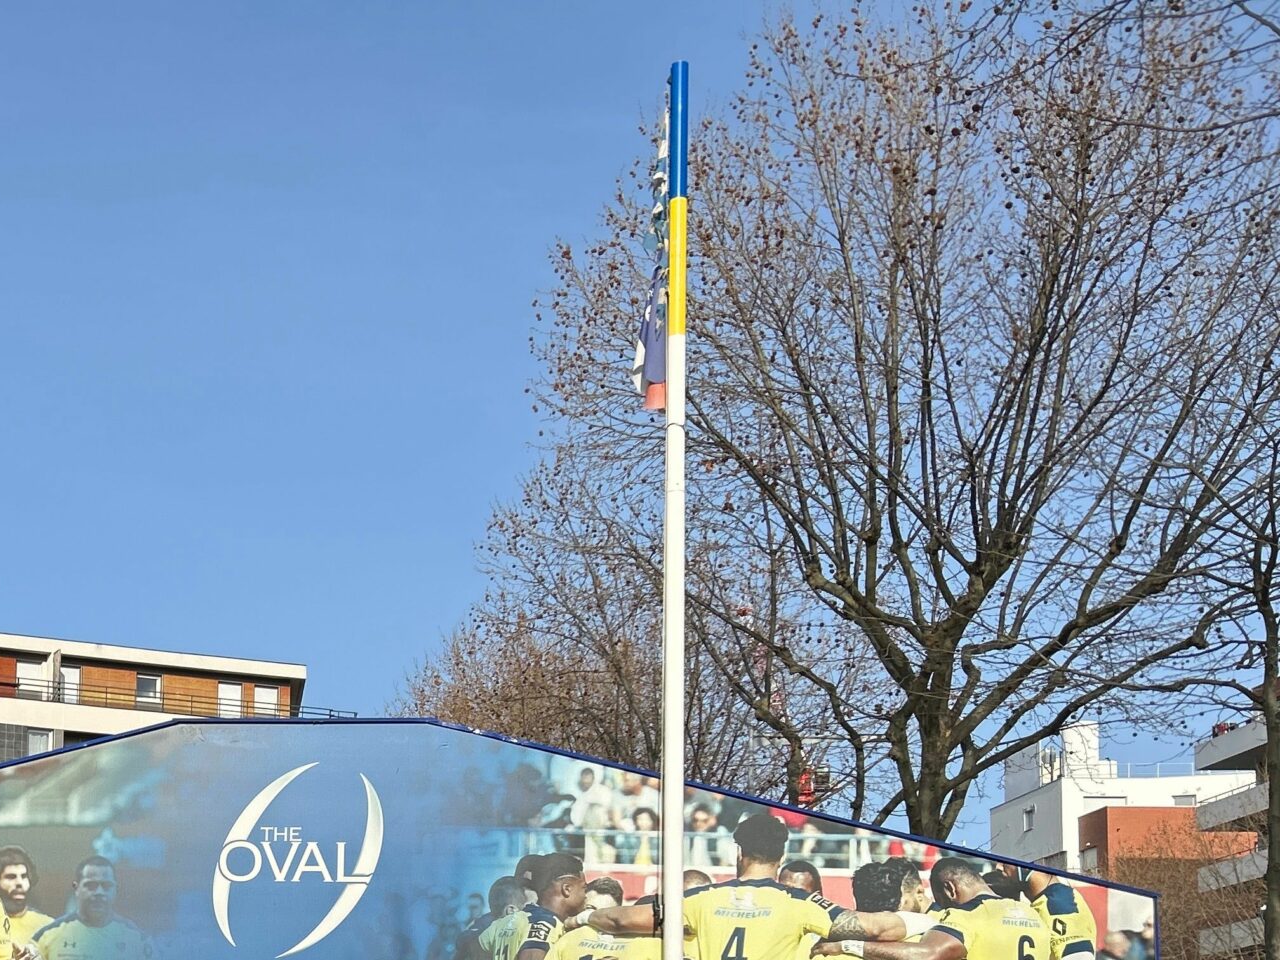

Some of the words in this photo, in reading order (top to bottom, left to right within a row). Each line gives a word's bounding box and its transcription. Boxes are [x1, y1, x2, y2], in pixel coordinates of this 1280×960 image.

[261, 826, 301, 841] THE
[219, 840, 372, 884] OVAL
[714, 909, 772, 918] MICHELIN
